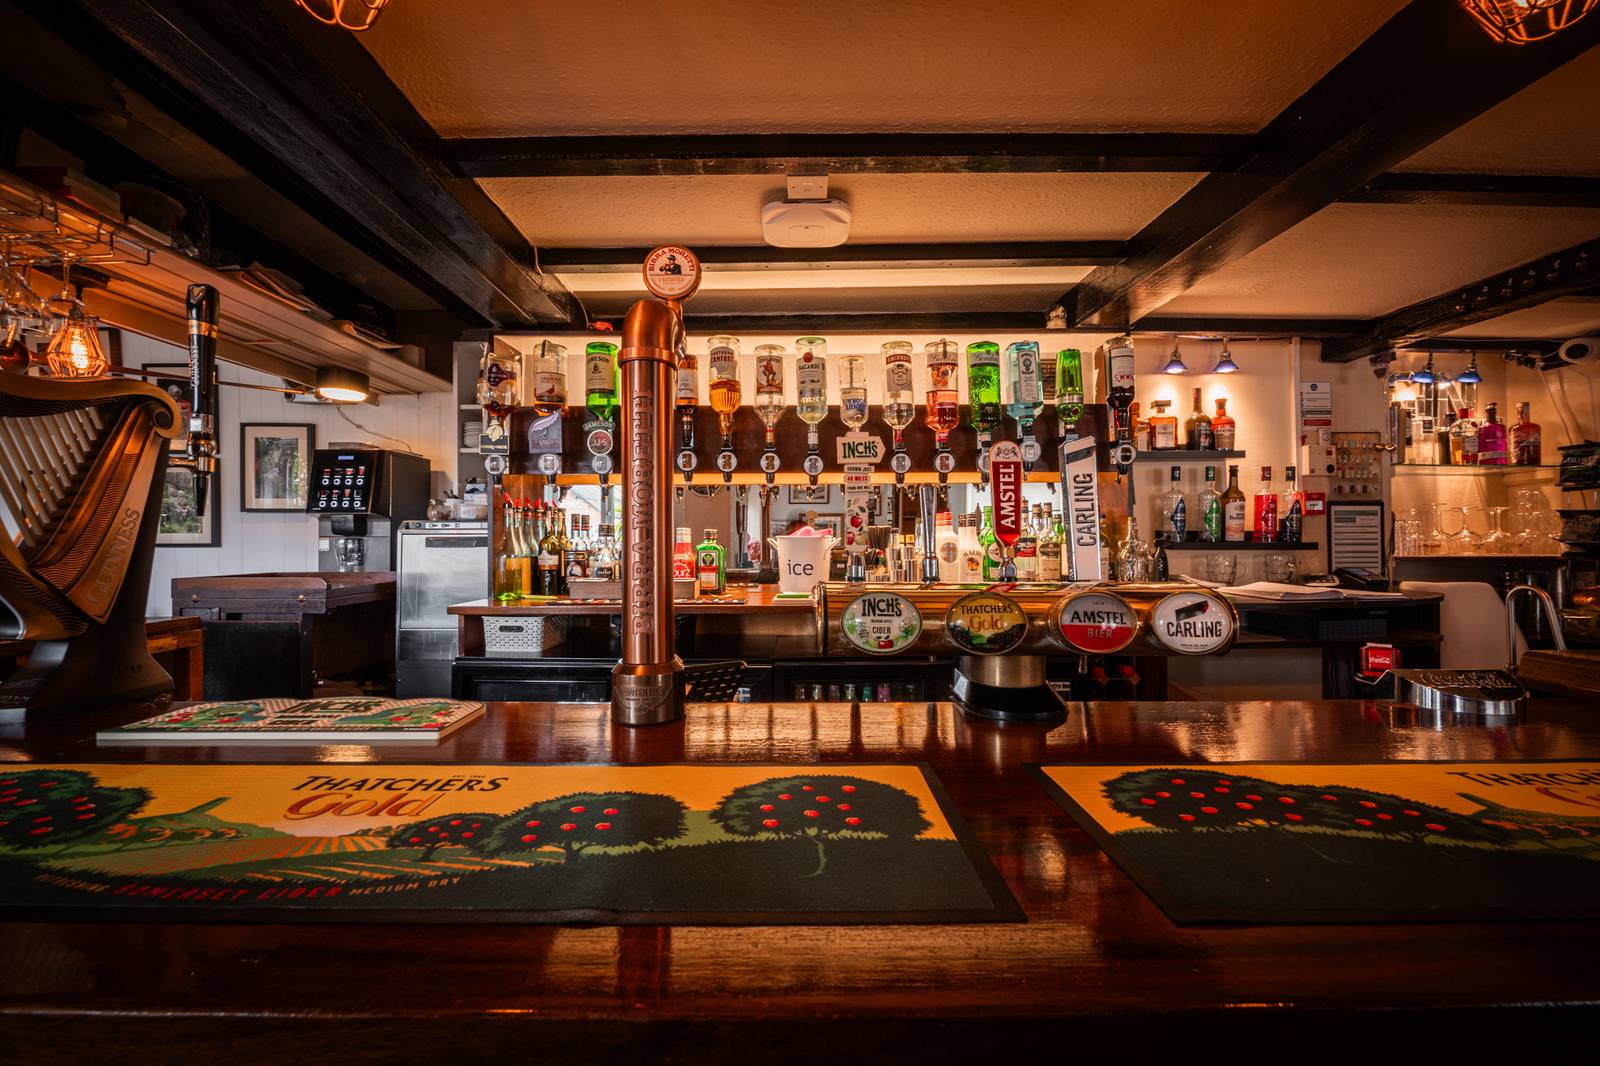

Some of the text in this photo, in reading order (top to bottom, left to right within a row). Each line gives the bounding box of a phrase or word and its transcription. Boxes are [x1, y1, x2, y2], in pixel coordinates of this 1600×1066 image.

[648, 248, 696, 272] BIRRA MORETTI
[841, 440, 878, 459] INCH'S
[999, 464, 1016, 529] AMSTEL
[631, 389, 655, 636] BIRRA MORETTI
[1073, 472, 1097, 548] CARLING
[87, 507, 140, 607] GUINNESS
[787, 559, 814, 576] ice
[861, 598, 902, 617] INCH'S
[960, 603, 1014, 615] THATCHERS
[968, 615, 1003, 633] Gold
[1070, 610, 1127, 625] AMSTEL
[872, 626, 891, 634] CIDER
[1087, 628, 1113, 639] BIER
[1166, 621, 1223, 638] CARLING
[291, 776, 509, 792] THATCHERS
[1446, 771, 1600, 787] THATCH
[283, 793, 446, 821] Gold
[112, 876, 461, 900] SOMERSET CIDER MEDIUM DRY
